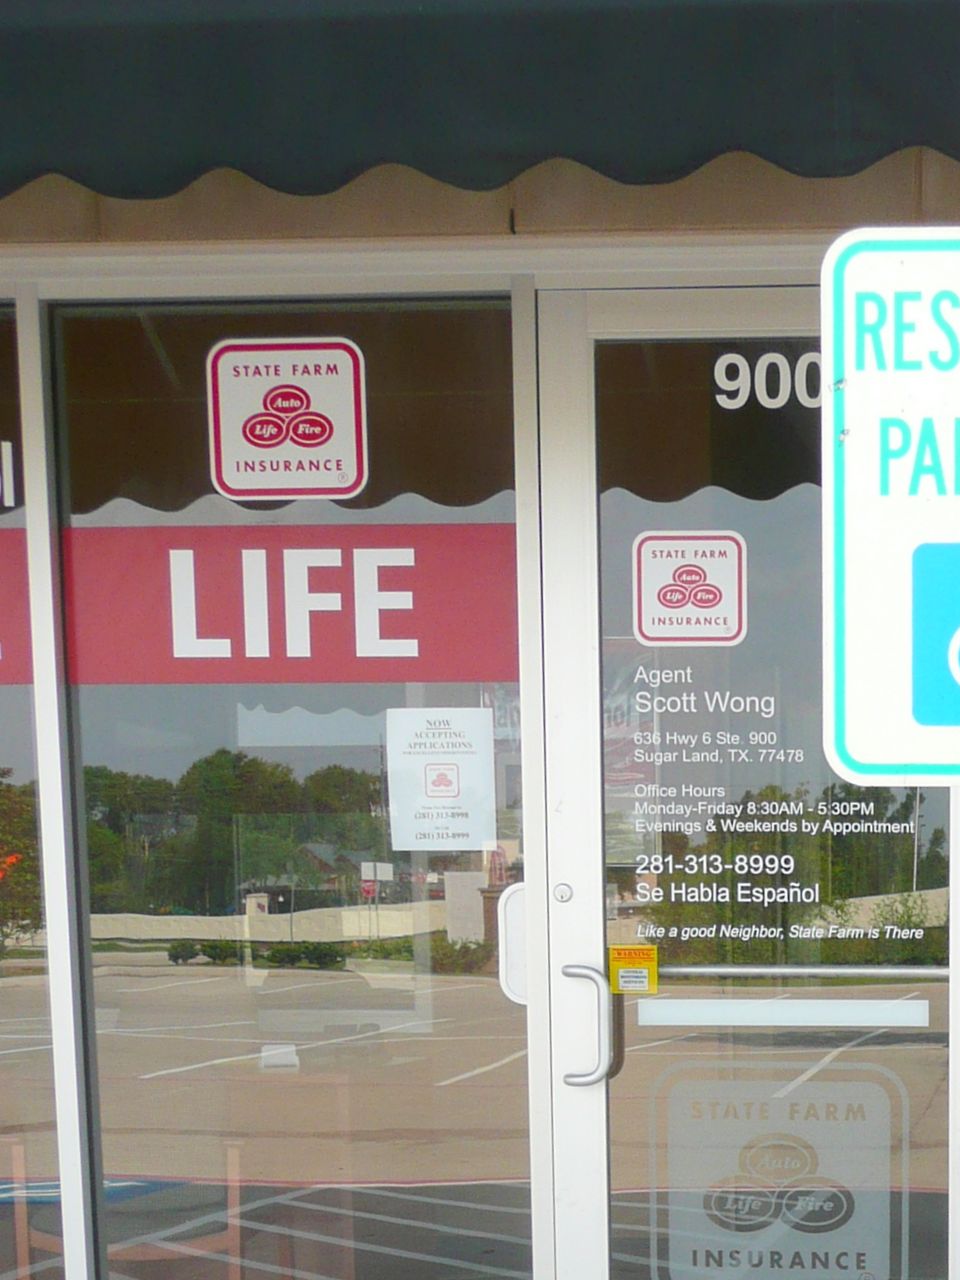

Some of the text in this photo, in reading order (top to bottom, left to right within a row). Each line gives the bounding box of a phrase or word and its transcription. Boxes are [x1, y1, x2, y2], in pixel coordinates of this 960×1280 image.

[232, 363, 339, 377] STATE FARM
[713, 351, 821, 410] 900
[273, 397, 301, 408] Auto
[254, 423, 322, 438] Life Fire
[235, 459, 343, 472] INSURANCE
[651, 549, 728, 559] STATE FARM
[169, 548, 419, 659] LIFE
[651, 616, 728, 626] INSURANCE
[633, 665, 693, 688] Agent
[635, 691, 776, 718] Scott Wong
[424, 718, 452, 728] NOW
[413, 731, 466, 739] ACCEPTING
[633, 731, 777, 749] 636 Hwy 6 Ste. 900
[407, 741, 474, 750] APPLICATIONS
[633, 749, 804, 767] Sugar Land, TX. 77478
[634, 784, 726, 797] Office Hours
[634, 802, 743, 820] Monday-Friday
[746, 802, 804, 816] 8:30AM
[817, 802, 875, 816] 5:30PM
[634, 820, 915, 838] Evenings & Weekends by Appointment
[634, 854, 796, 875] 281-313-8999
[635, 880, 820, 907] Se Habla Español
[636, 923, 925, 943] Like a good Neighbor, State Farm is There
[691, 1101, 867, 1122] STATE FARM
[756, 1157, 801, 1171] Auto
[724, 1196, 834, 1214] Life Fire
[691, 1249, 867, 1271] INSURANCE
